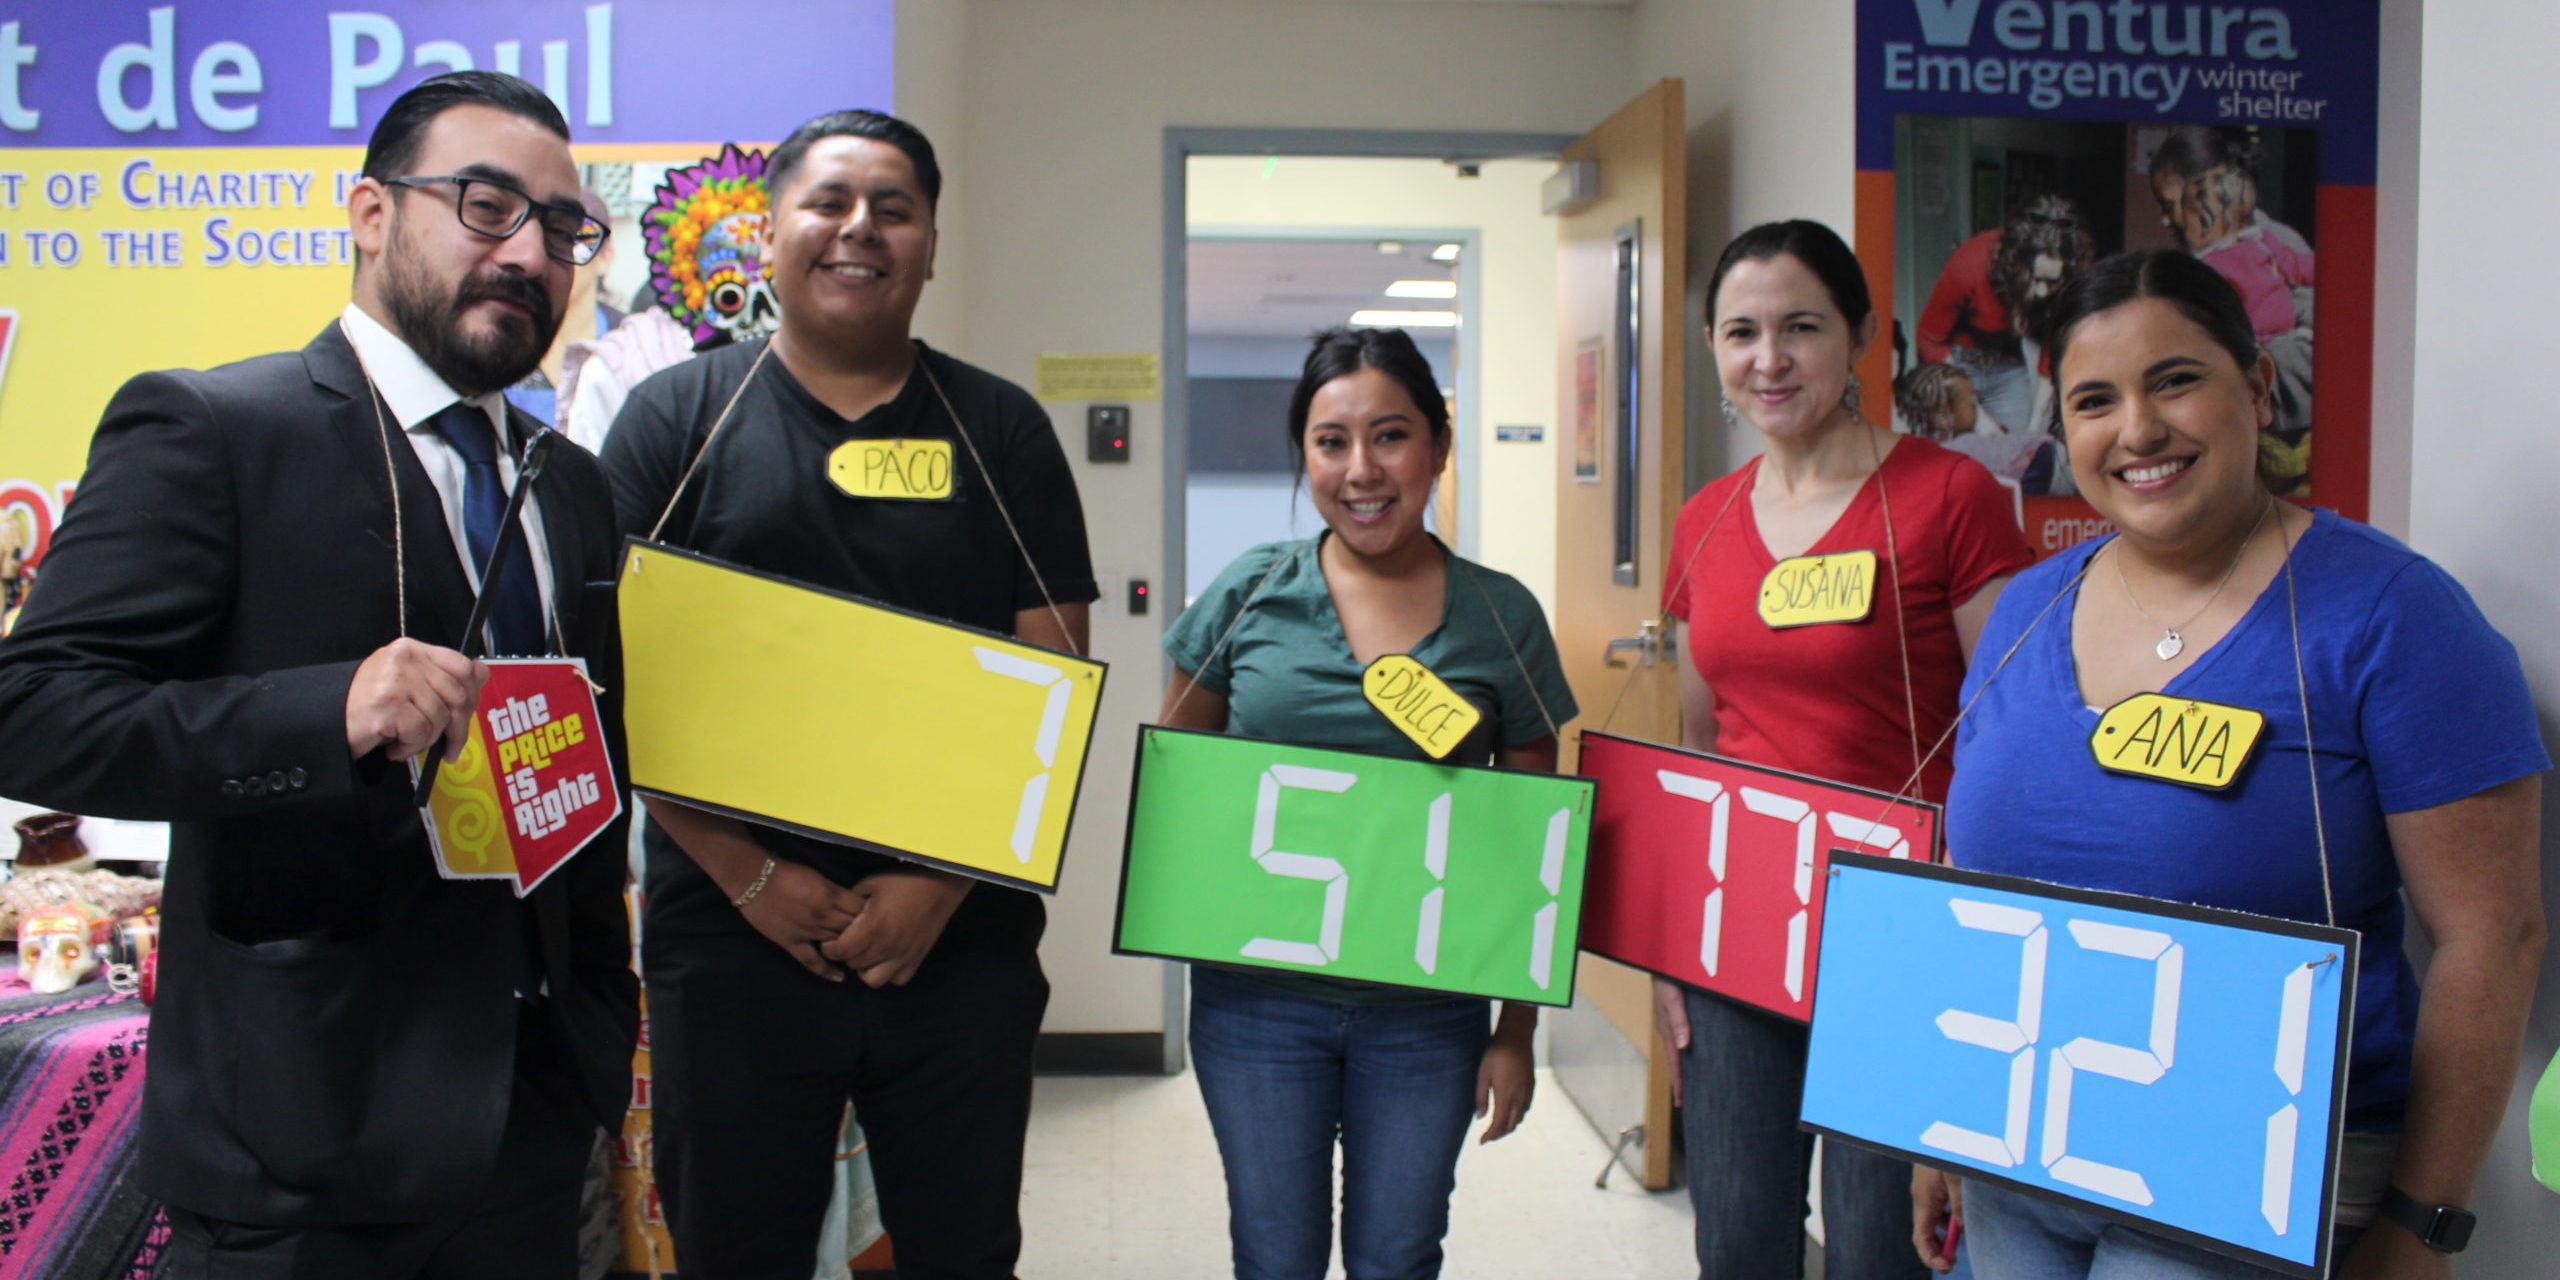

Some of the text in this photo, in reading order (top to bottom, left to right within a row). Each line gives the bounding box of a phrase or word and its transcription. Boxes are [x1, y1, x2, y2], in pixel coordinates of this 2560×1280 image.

[1914, 0, 2298, 60] Ventura
[97, 5, 264, 132] de
[1883, 41, 2304, 113] Emergency winter
[2218, 89, 2328, 120] shelter
[863, 446, 949, 495] PACO
[1768, 562, 1866, 614] SUSANA
[1376, 667, 1465, 748] DULCE
[2113, 705, 2231, 780] ANA
[971, 645, 1073, 865] 7
[1239, 763, 1571, 991] 511
[1919, 897, 2313, 1236] 321
